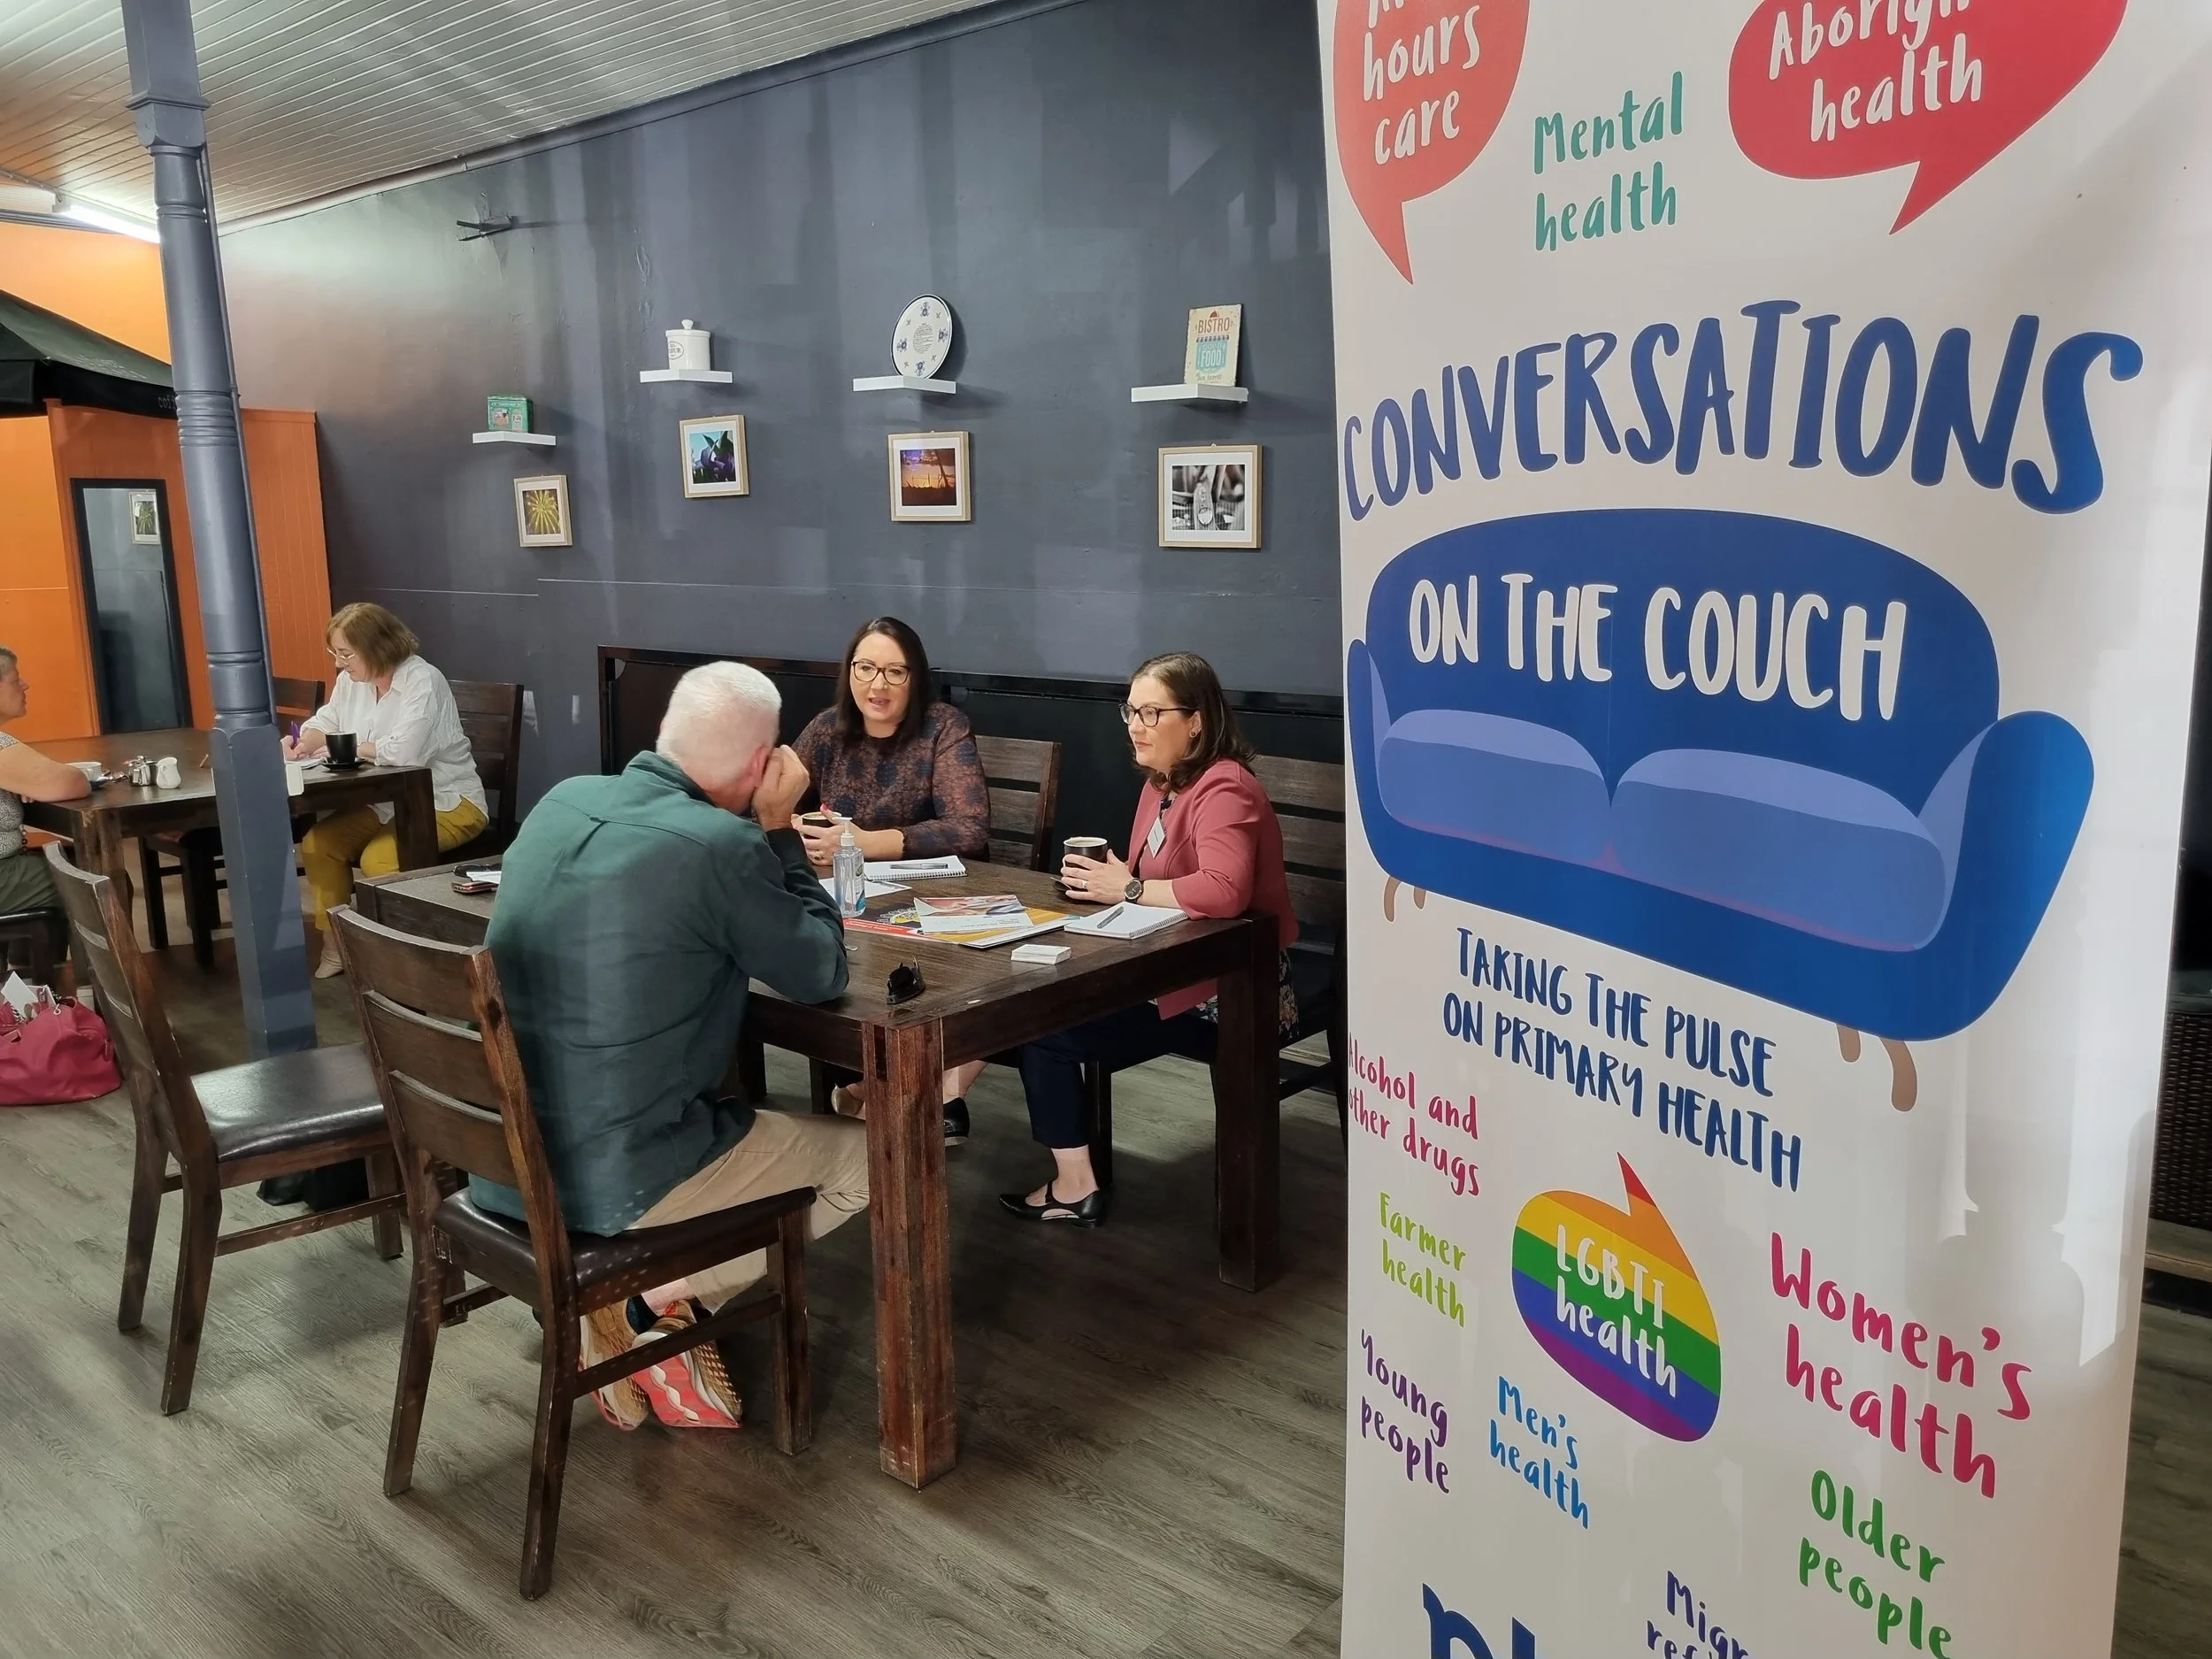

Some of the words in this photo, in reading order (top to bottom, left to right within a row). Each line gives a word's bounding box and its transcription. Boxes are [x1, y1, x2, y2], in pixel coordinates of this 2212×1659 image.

[1363, 6, 1479, 100] hours
[1811, 34, 1982, 141] health
[1375, 91, 1458, 164] care
[1534, 72, 1682, 174] Mental
[1536, 162, 1676, 250] health
[1196, 318, 1231, 334] BISTRO
[1200, 350, 1222, 367] FOOD
[1344, 299, 2144, 522] CONVERSATIONS
[1409, 575, 1479, 664] ON
[1501, 573, 1617, 681] THE
[1645, 588, 1906, 720] COUCH
[1457, 928, 1571, 1013] TAKING
[1586, 973, 1651, 1047] THE
[1665, 1006, 1776, 1097] PULSE
[1349, 1033, 1415, 1110] Alcohol
[1429, 1095, 1478, 1140] and
[1444, 993, 1482, 1046] ON
[1494, 1011, 1642, 1118] PRIMARY
[1659, 1082, 1801, 1191] HEALTH
[1349, 1087, 1390, 1139] other
[1403, 1118, 1479, 1195] drugs
[1380, 1193, 1466, 1271] Farmer
[1383, 1242, 1464, 1327] health
[1557, 1228, 1663, 1325] LGBTI
[1557, 1279, 1676, 1397] health
[1771, 1233, 2032, 1420] Women's
[1362, 1329, 1447, 1449] Young
[1499, 1376, 1578, 1468] Men's
[1786, 1324, 1995, 1499] health
[1362, 1396, 1449, 1494] people
[1490, 1419, 1588, 1529] health
[1811, 1470, 1945, 1583] Older
[1800, 1537, 1951, 1659] people
